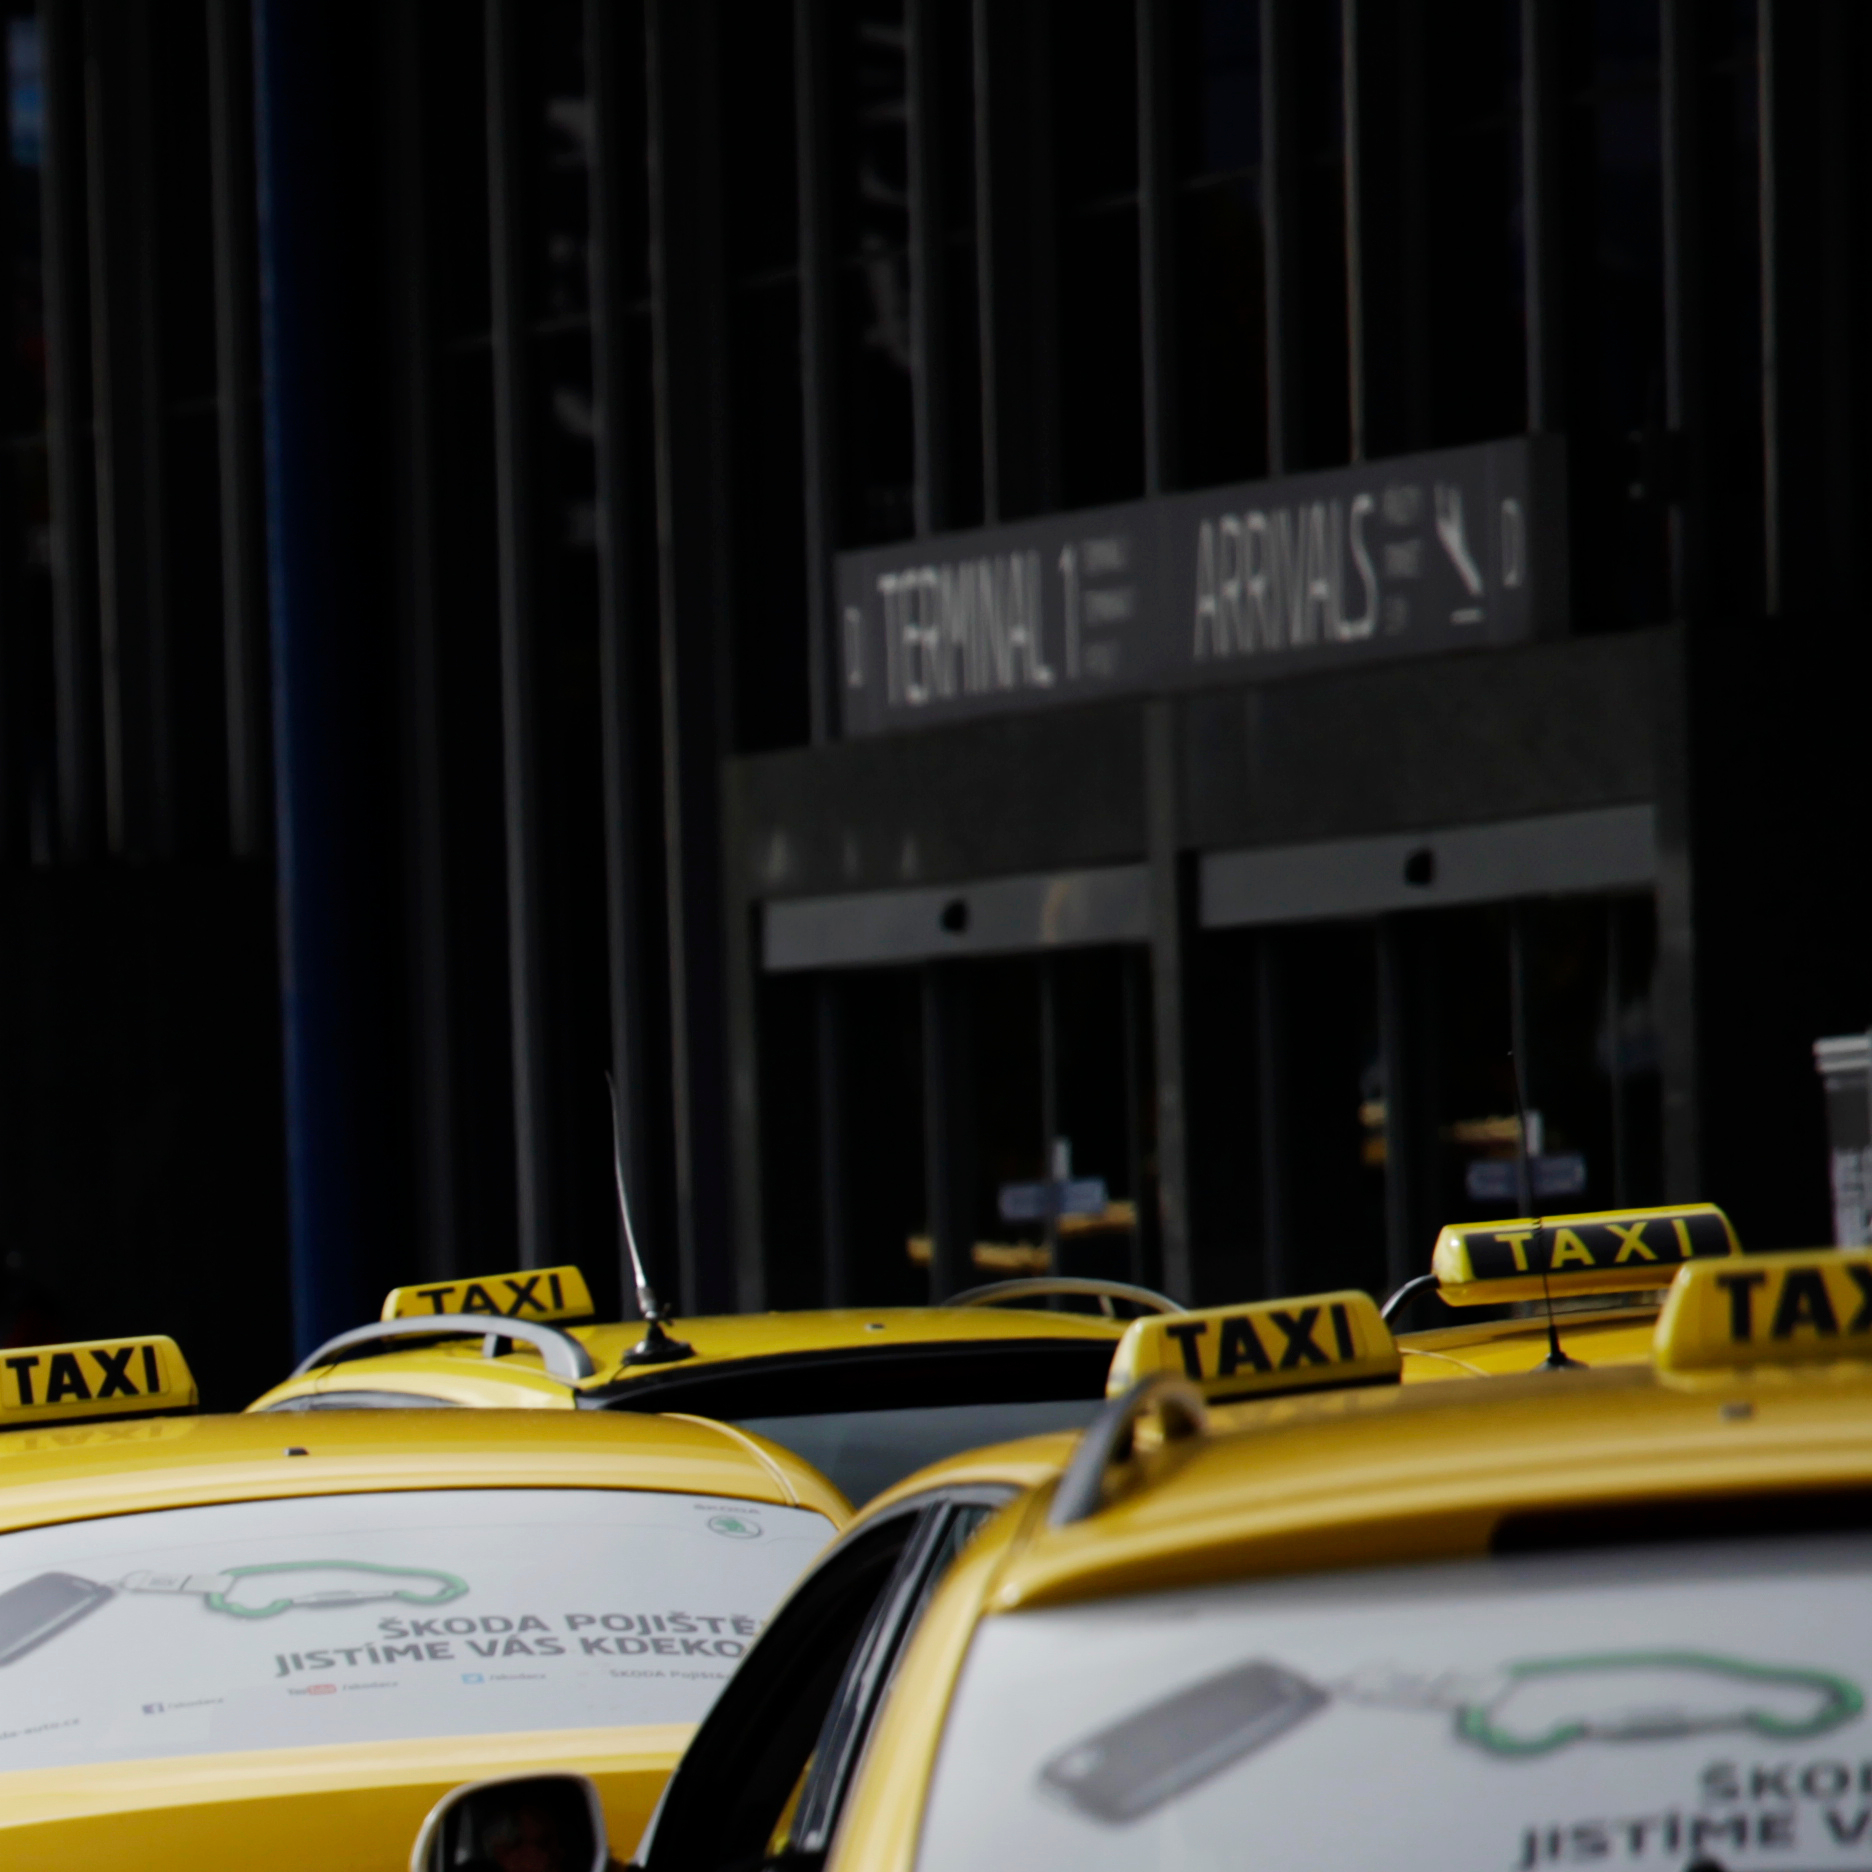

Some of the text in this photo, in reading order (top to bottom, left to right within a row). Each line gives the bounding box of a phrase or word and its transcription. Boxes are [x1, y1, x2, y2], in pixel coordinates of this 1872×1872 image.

[877, 549, 1055, 705] TERMINAL
[1058, 542, 1080, 679] 1
[1194, 492, 1378, 660] ARRIVALS
[1495, 1218, 1695, 1272] TAXI
[416, 1272, 564, 1318] TAXI
[1166, 1304, 1355, 1381] TAXI
[6, 1345, 161, 1405] TAXI
[378, 1610, 766, 1640] ŠKODA POJIŠTĚ
[274, 1640, 455, 1678] JISTÍME
[465, 1635, 566, 1658] VÁS
